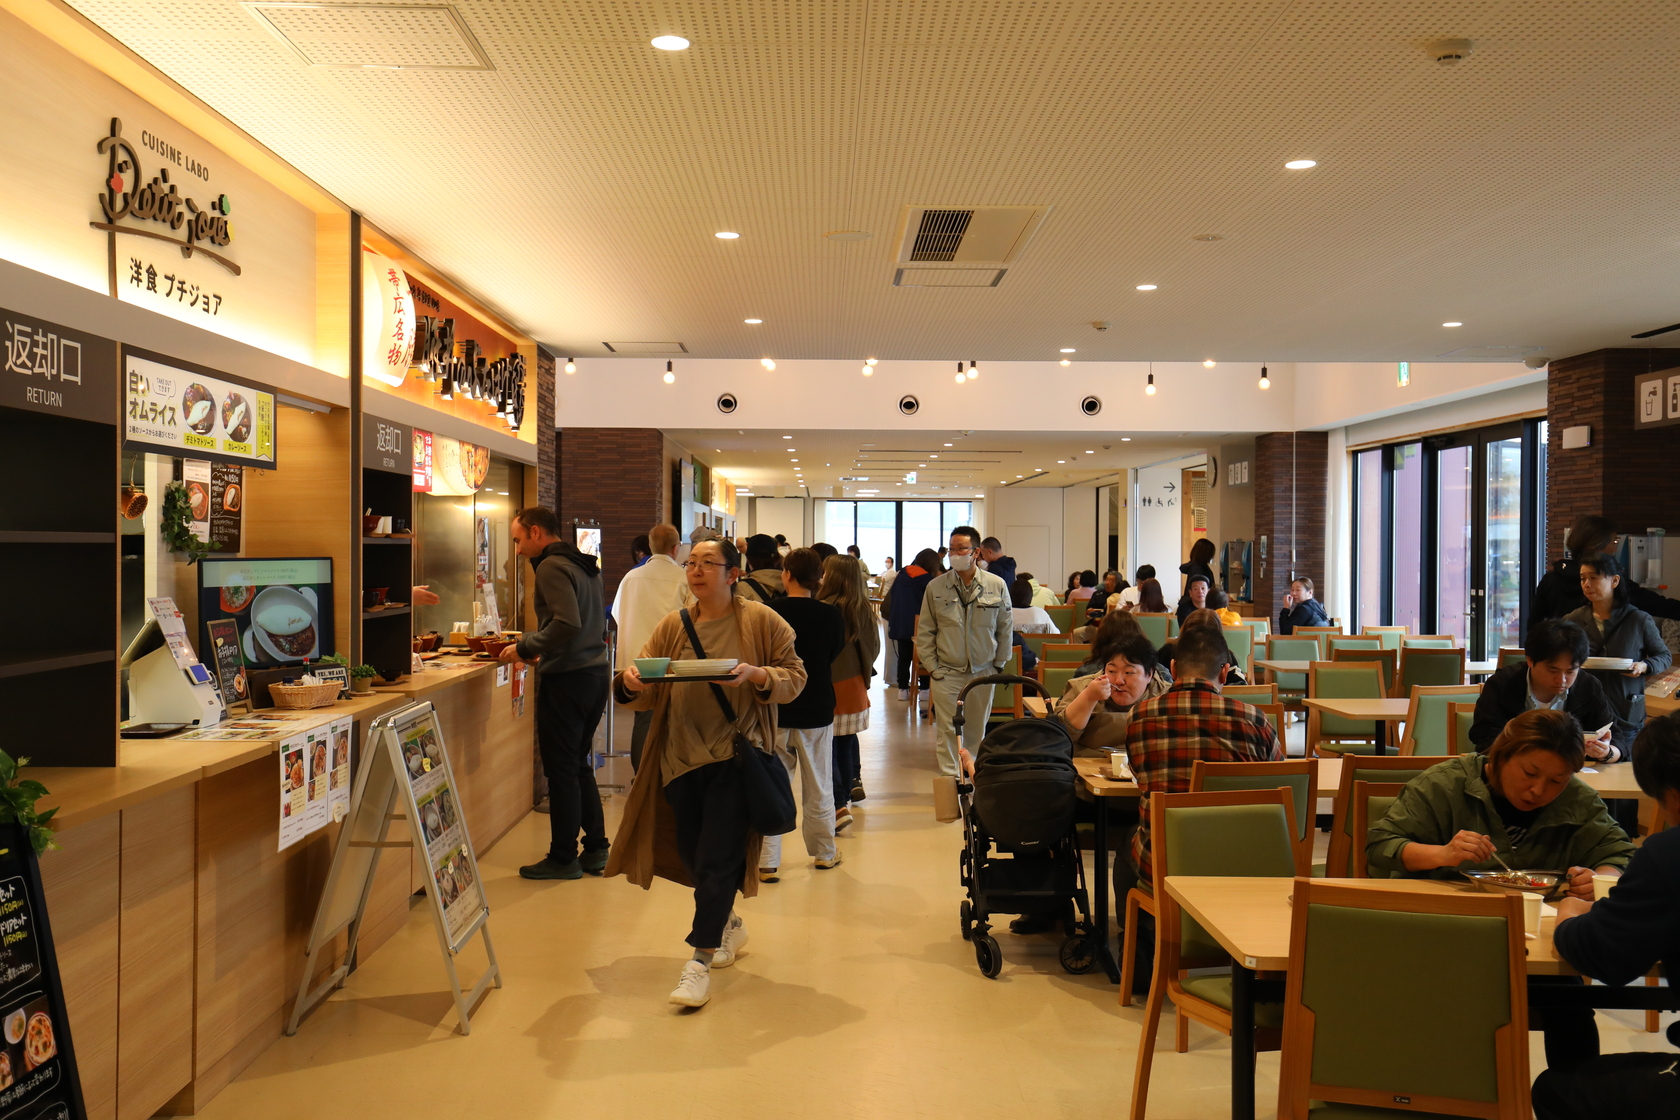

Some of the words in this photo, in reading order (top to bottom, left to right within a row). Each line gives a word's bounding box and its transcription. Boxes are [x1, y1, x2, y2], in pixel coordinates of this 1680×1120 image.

[141, 129, 182, 167] CUISINE
[185, 154, 210, 183] LABO
[130, 256, 158, 294] 洋食
[164, 274, 223, 316] プチジョア
[5, 320, 82, 386] 返却口
[26, 386, 63, 408] RETURN
[128, 397, 178, 428] オムライス
[376, 422, 402, 455] 返却口
[382, 457, 396, 468] RETURN
